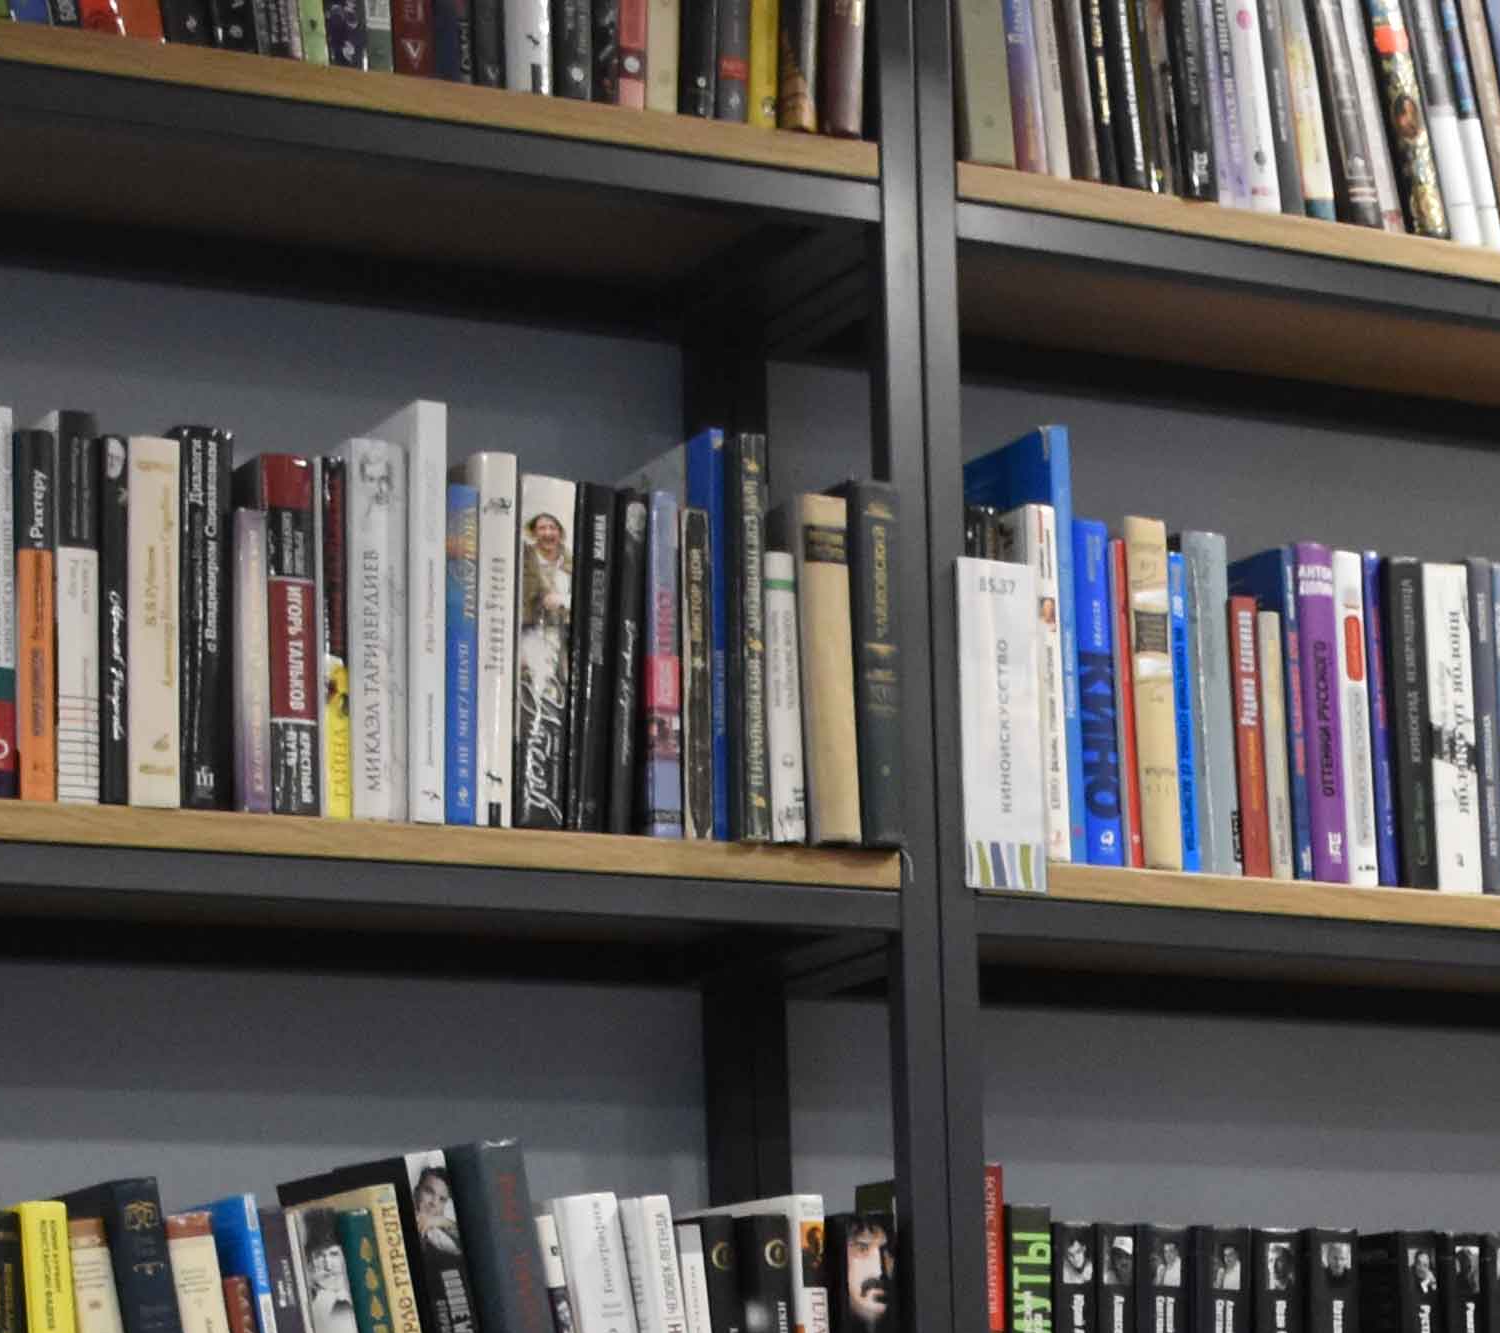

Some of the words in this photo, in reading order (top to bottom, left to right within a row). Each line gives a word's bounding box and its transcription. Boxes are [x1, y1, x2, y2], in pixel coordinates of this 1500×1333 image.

[29, 470, 48, 539] Рихтеру
[1314, 641, 1330, 722] РУССКОГО
[996, 639, 1013, 813] КИНОИСКУССТВО
[1319, 726, 1334, 796] ОТТЕНКИ
